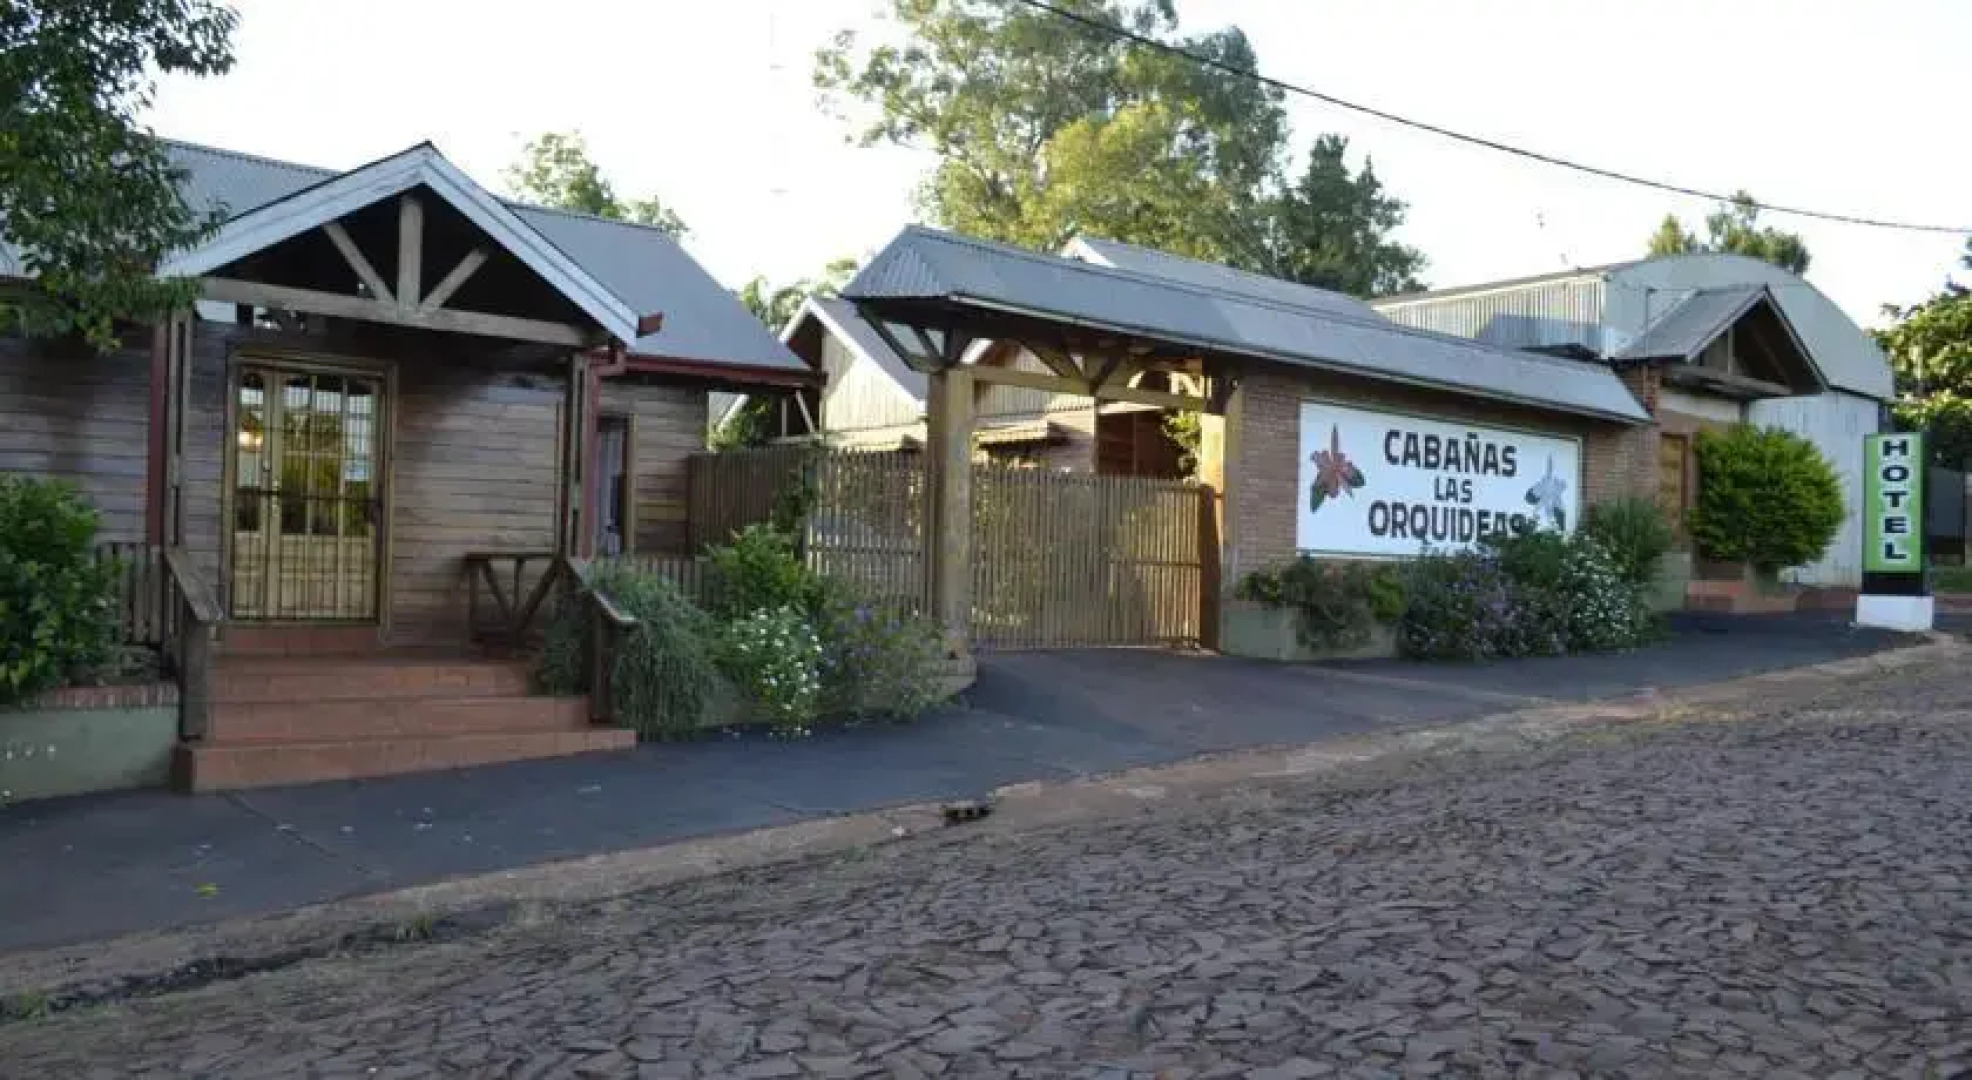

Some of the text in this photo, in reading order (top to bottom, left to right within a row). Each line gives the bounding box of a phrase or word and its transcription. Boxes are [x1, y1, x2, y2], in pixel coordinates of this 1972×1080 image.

[1384, 429, 1517, 477] CABAÑAS
[1434, 477, 1473, 503] LAS
[1882, 440, 1909, 560] HOTEL
